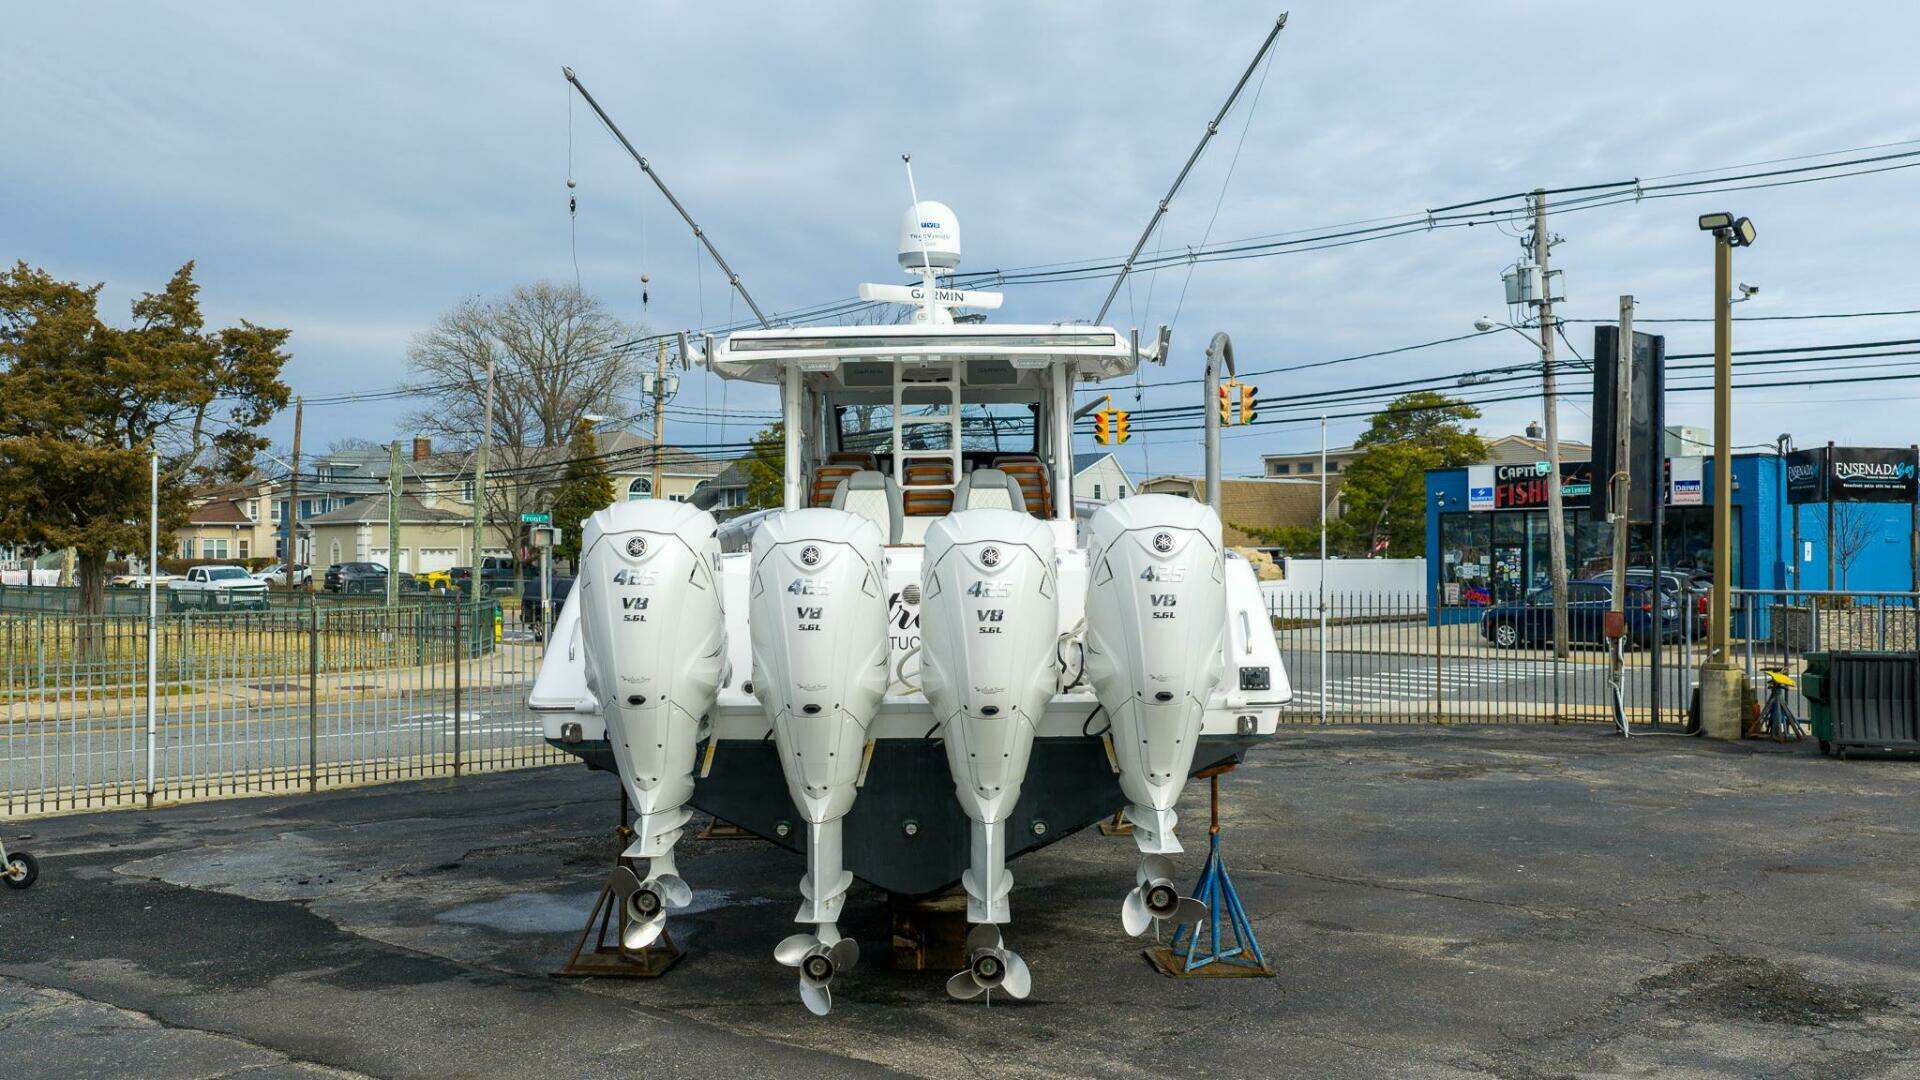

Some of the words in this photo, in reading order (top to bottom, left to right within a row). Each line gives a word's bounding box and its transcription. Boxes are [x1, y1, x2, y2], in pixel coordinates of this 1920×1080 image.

[1835, 462, 1899, 479] ENSENADA
[622, 597, 649, 610] V8
[1150, 594, 1177, 606] V8
[797, 607, 823, 619] V8
[977, 609, 1004, 622] V8
